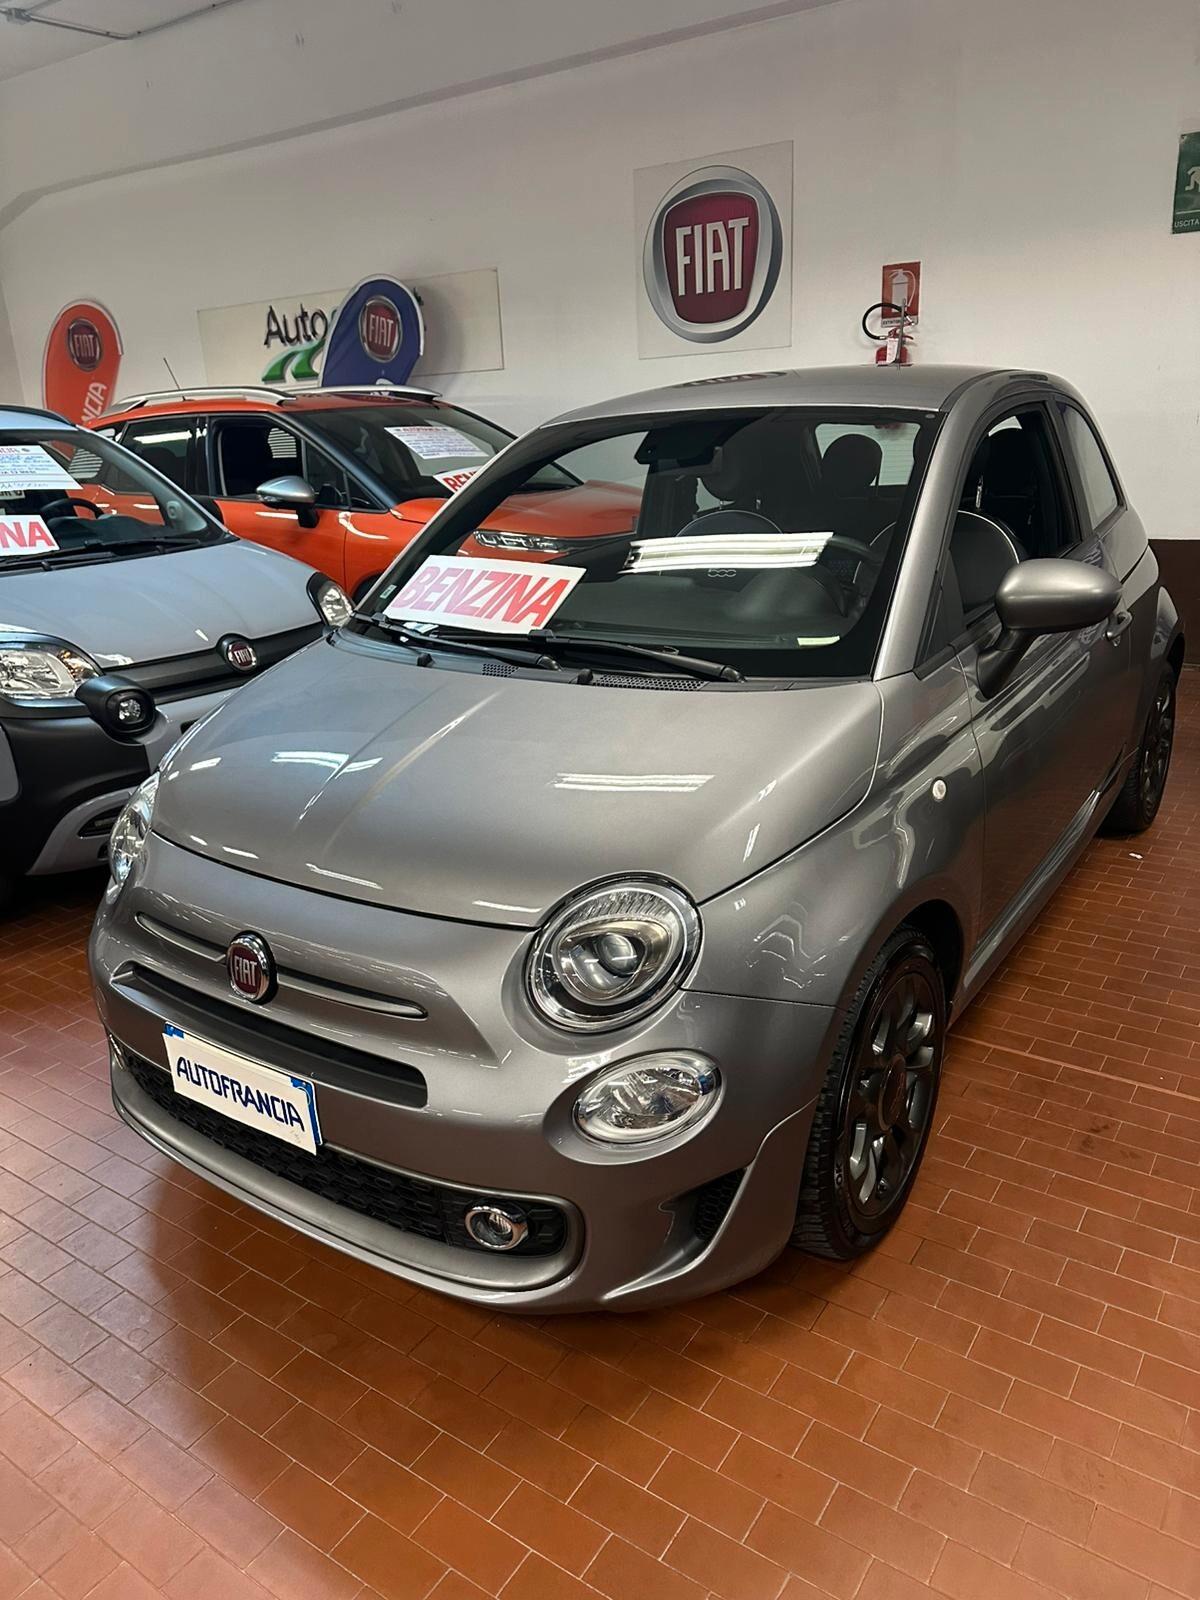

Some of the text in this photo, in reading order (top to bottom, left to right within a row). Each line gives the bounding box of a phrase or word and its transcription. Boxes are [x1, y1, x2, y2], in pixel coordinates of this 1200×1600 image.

[675, 216, 750, 297] FIAT
[73, 333, 96, 358] FIAT
[369, 313, 395, 348] FIAT
[390, 566, 571, 627] BENZINA
[234, 955, 258, 987] FIAT
[176, 1056, 306, 1133] AUTOFRANCIA
